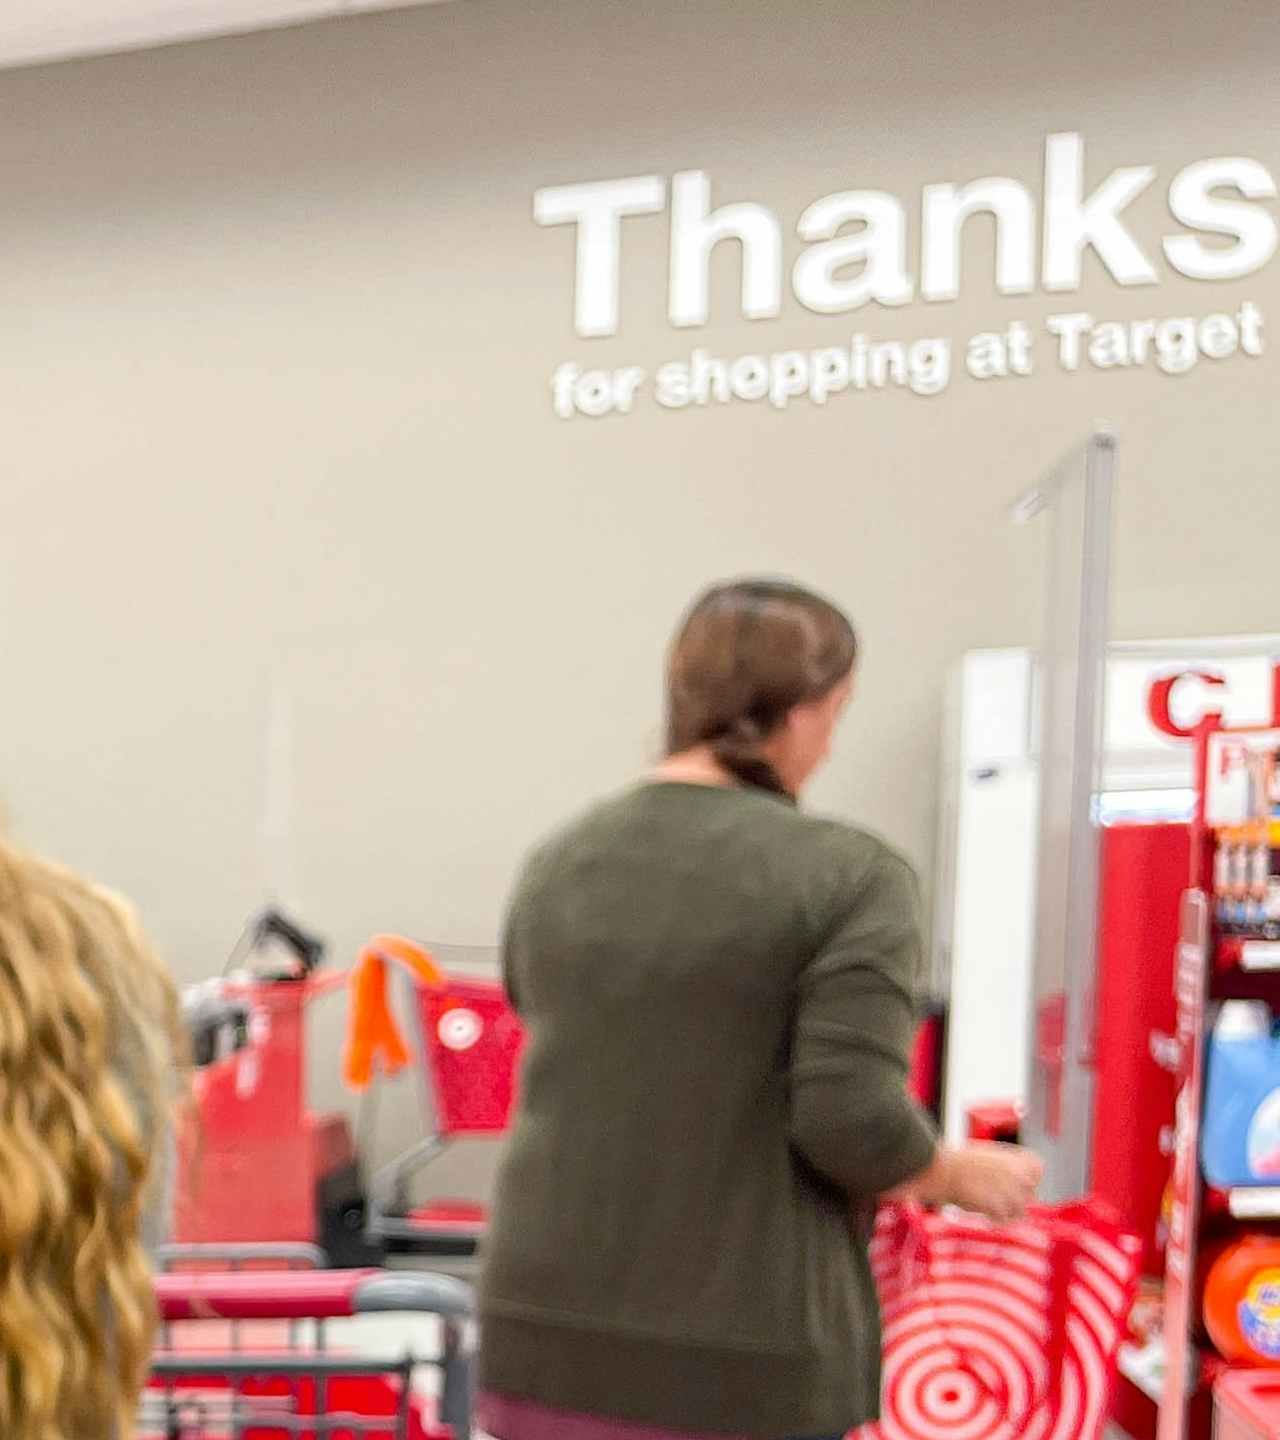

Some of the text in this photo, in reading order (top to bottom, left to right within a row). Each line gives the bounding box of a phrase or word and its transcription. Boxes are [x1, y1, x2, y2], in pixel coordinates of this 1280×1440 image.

[532, 130, 1278, 337] Thanks
[551, 301, 1263, 418] for shopping at Target
